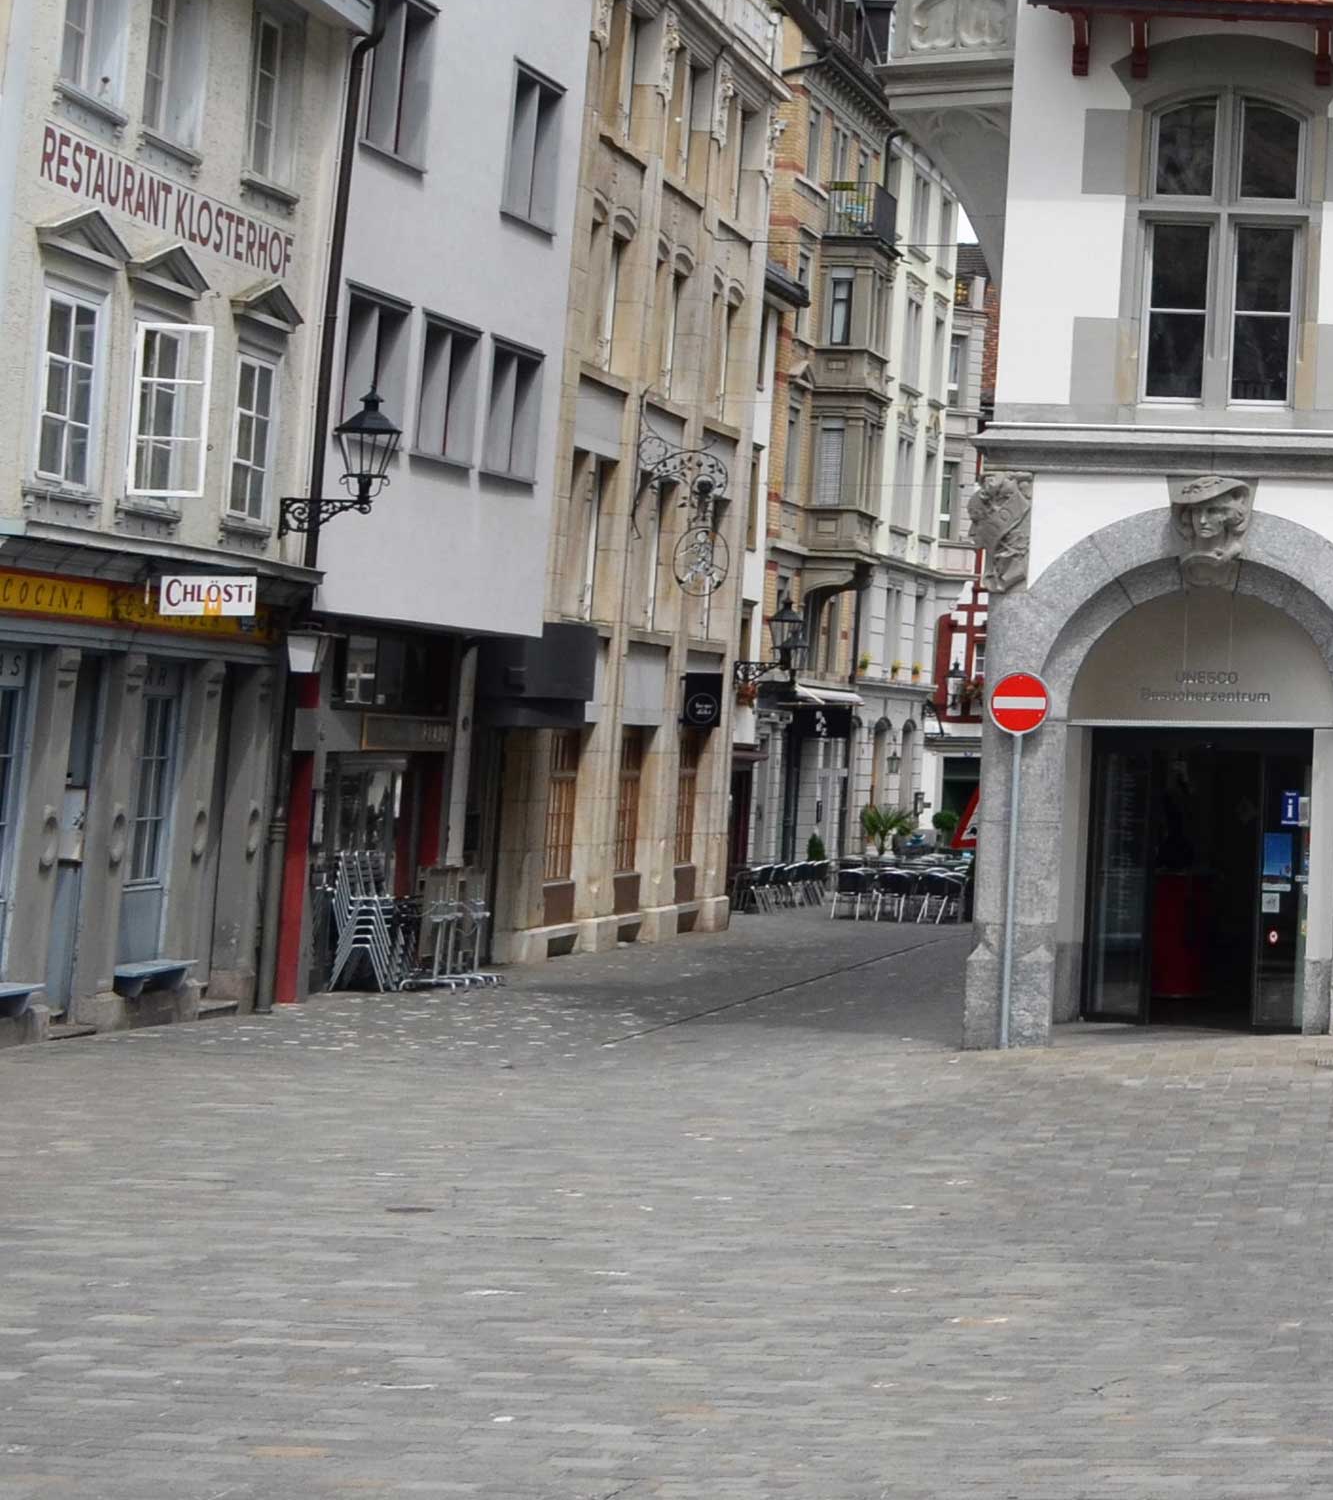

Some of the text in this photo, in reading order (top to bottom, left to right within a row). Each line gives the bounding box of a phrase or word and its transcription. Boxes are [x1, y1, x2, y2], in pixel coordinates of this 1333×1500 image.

[40, 126, 294, 277] RESTAURANT KLOSTERHOF
[3, 578, 84, 611] COCINA
[1175, 671, 1239, 685] UNESCO
[1141, 689, 1271, 702] Besucherzentrum
